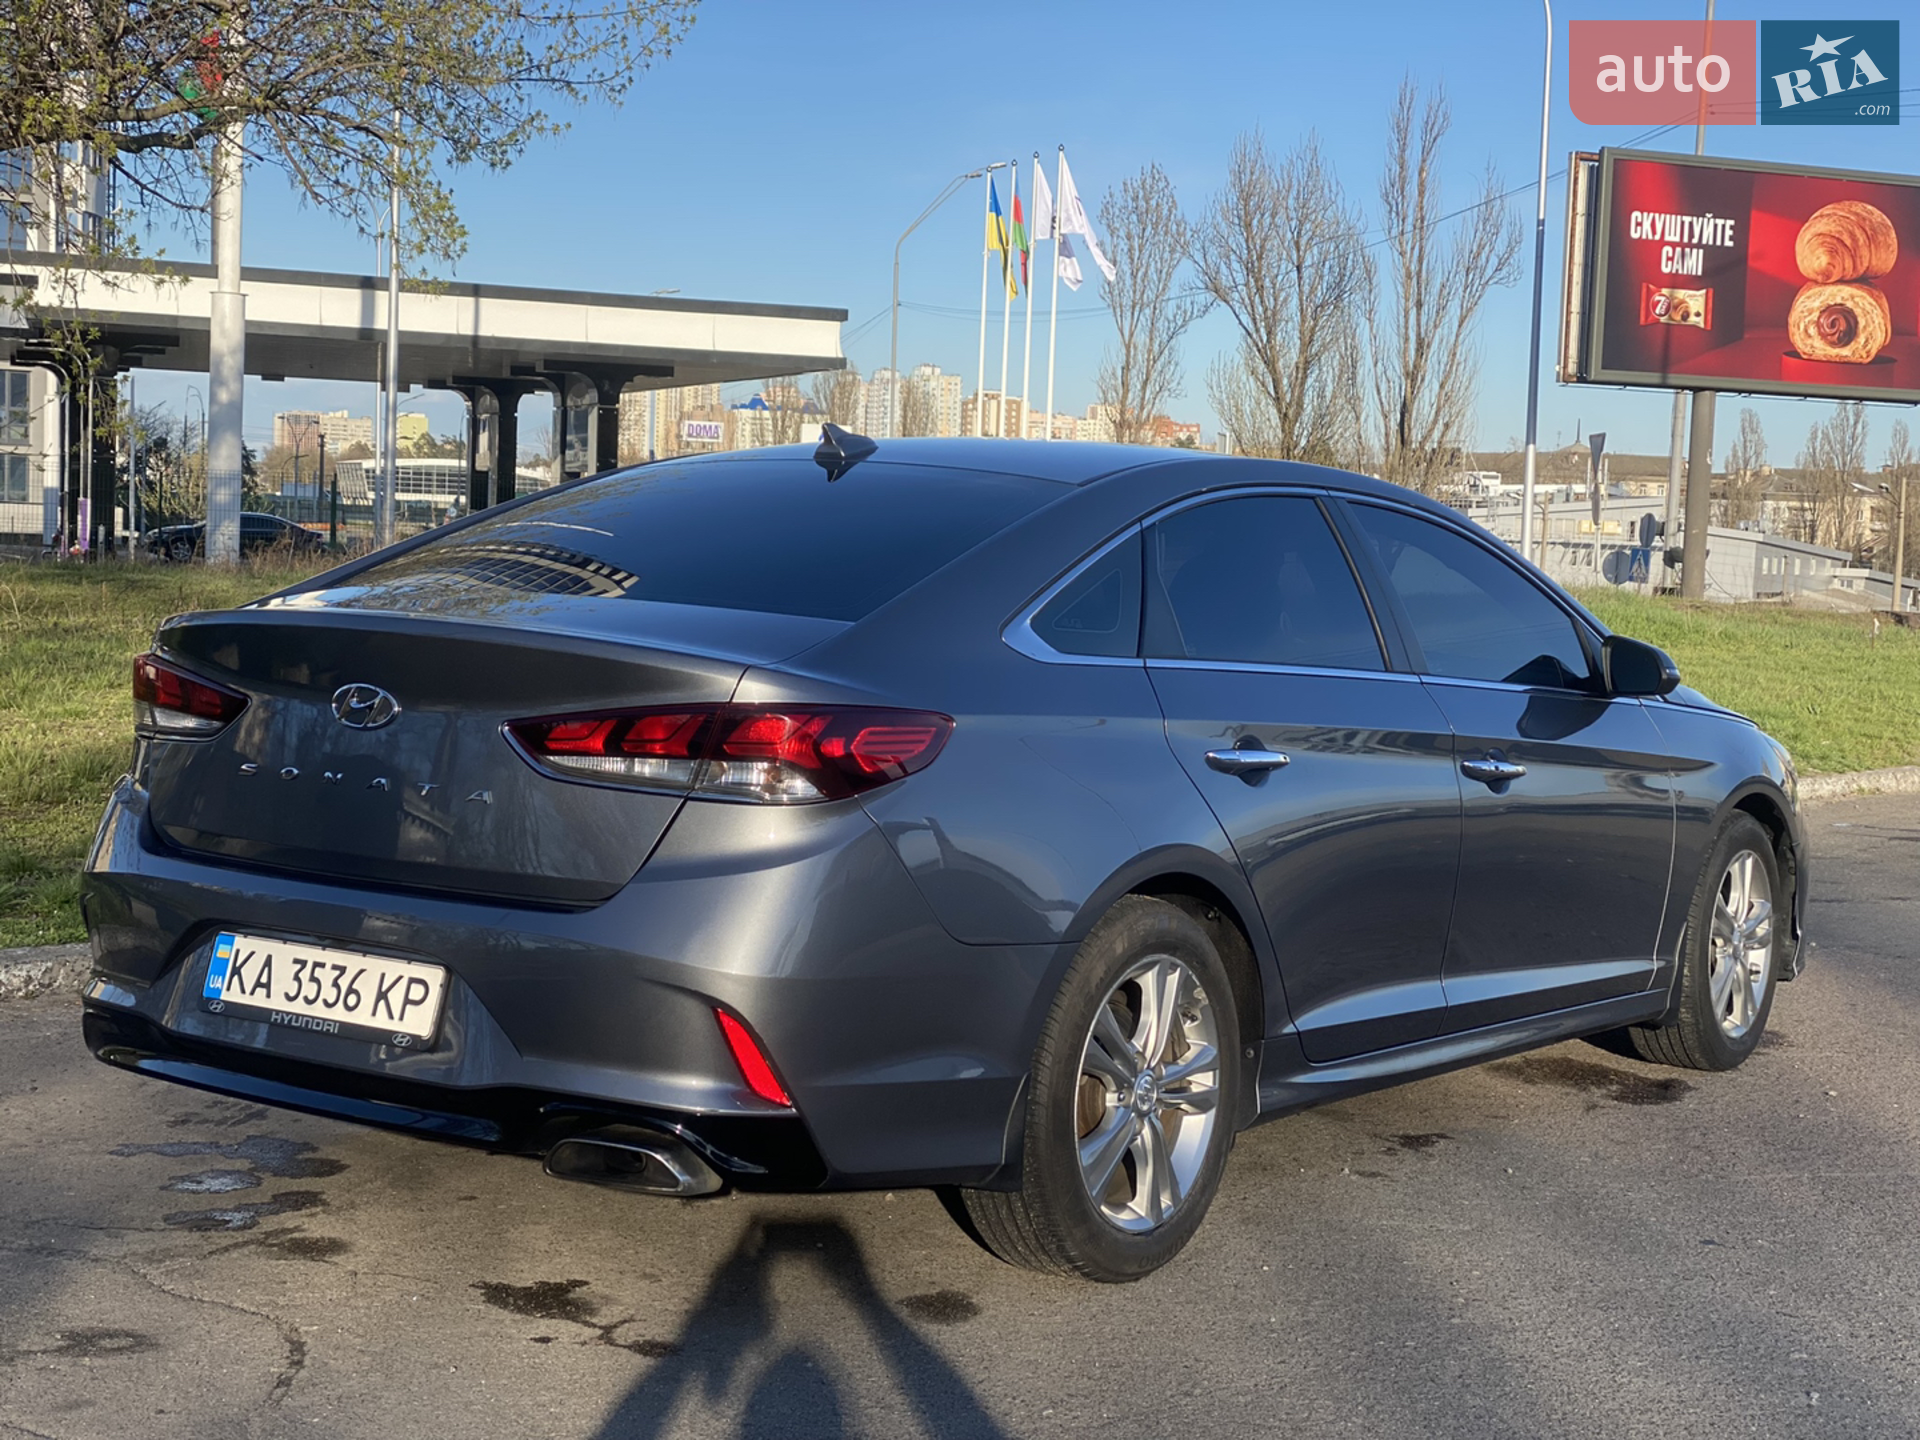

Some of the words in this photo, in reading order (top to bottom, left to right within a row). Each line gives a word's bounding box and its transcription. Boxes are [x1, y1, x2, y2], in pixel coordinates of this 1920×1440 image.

[1629, 210, 1736, 247] СКУШТУЙТЕ
[1660, 246, 1704, 276] САМІ
[687, 423, 720, 439] DOMA
[238, 763, 493, 804] SONATA
[208, 975, 223, 990] UA
[225, 948, 273, 999] KA
[283, 958, 368, 1013] 3536
[370, 972, 430, 1022] KP
[271, 1012, 339, 1034] HYUNDAI
